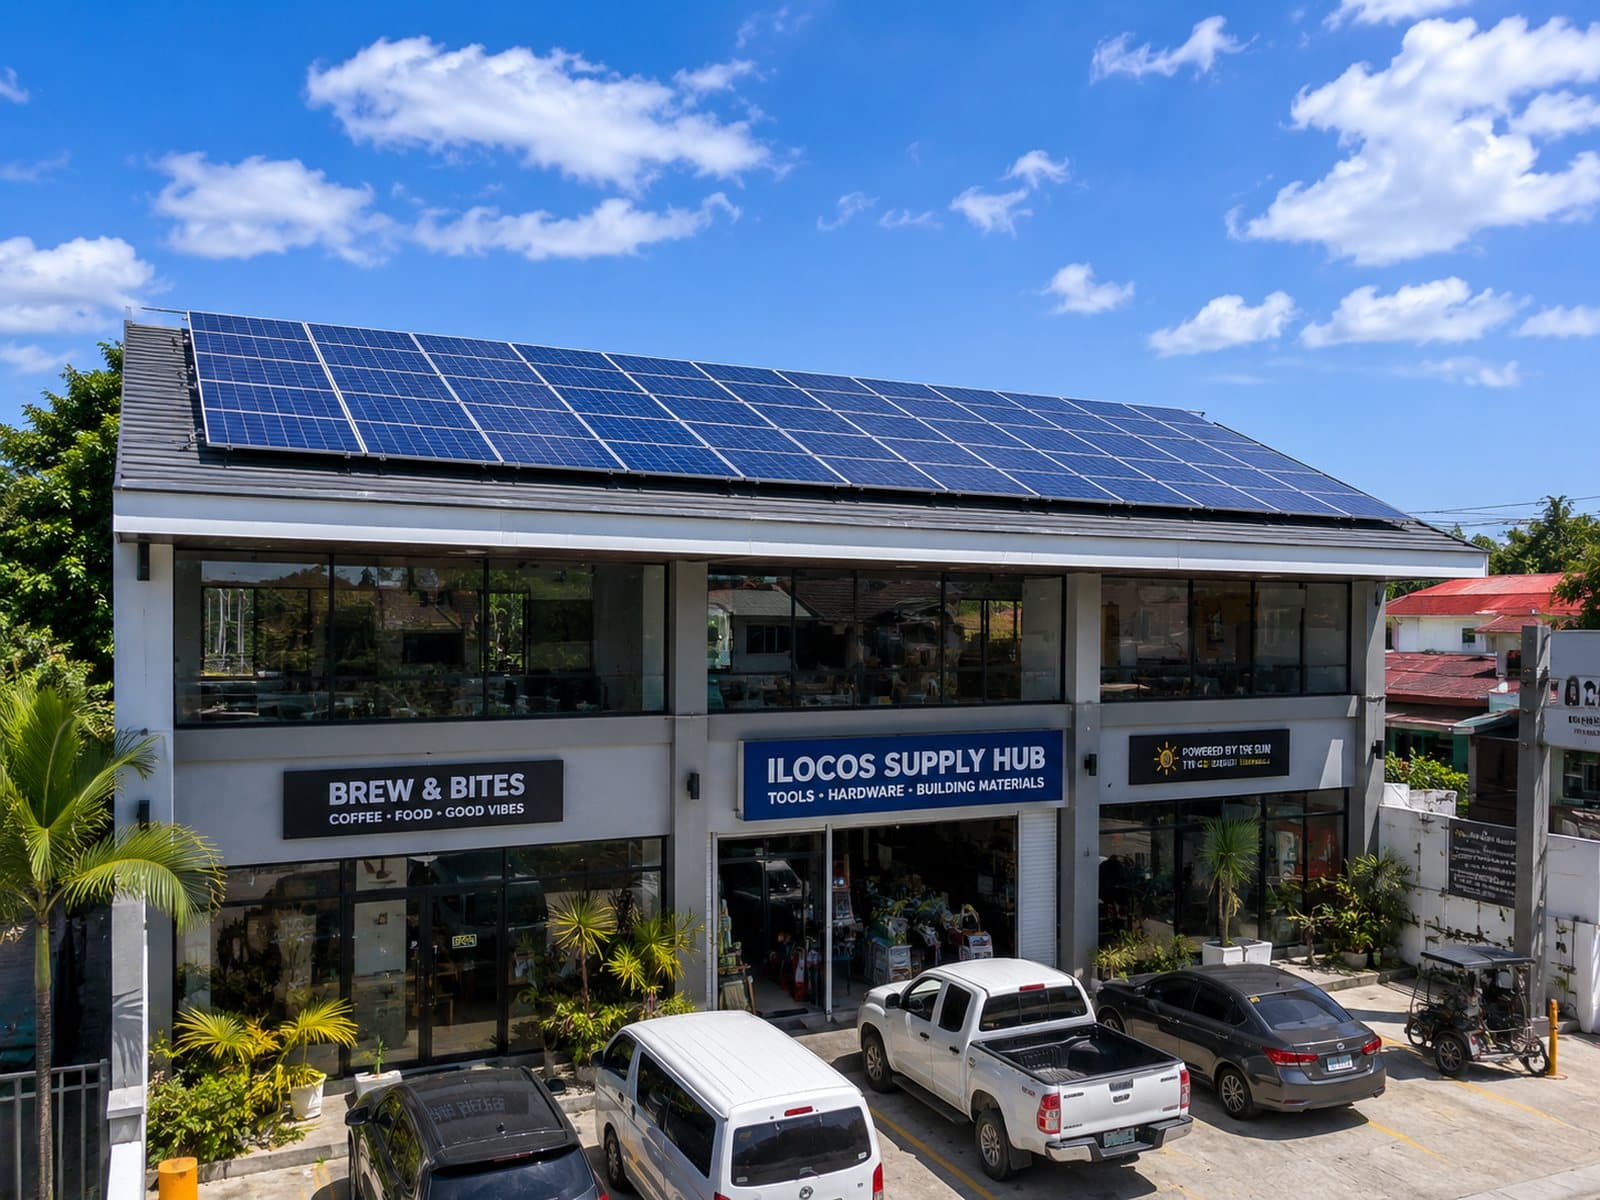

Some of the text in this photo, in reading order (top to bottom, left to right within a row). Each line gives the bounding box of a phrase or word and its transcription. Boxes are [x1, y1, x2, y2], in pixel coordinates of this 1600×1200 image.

[1225, 745, 1237, 755] BY
[768, 747, 1045, 783] ILOCOS SUPPLY HUB
[330, 773, 524, 805] BREW & BITES
[768, 777, 1044, 804] TOOLS HARDWARE BUILDING MATERIALS
[330, 803, 524, 824] COFFEE FOOD GOOD VIBES
